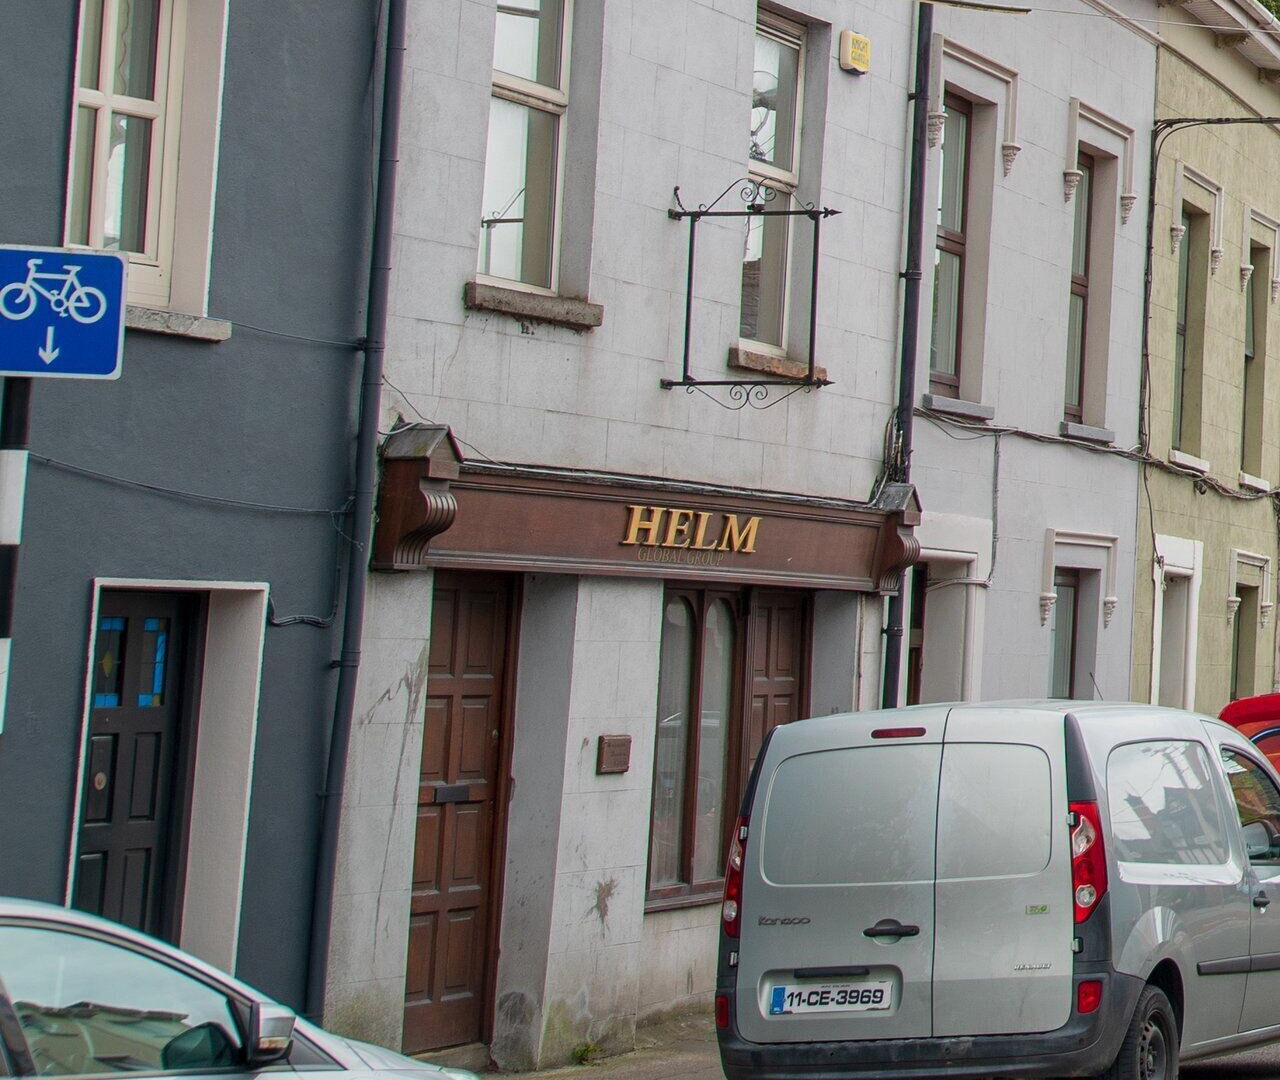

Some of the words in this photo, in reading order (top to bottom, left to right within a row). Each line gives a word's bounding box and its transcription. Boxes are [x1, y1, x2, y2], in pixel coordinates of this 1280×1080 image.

[620, 504, 763, 553] HELM
[637, 547, 682, 563] GLOBAL
[686, 551, 724, 566] GROUP
[786, 988, 884, 1007] 11-CE-3969
